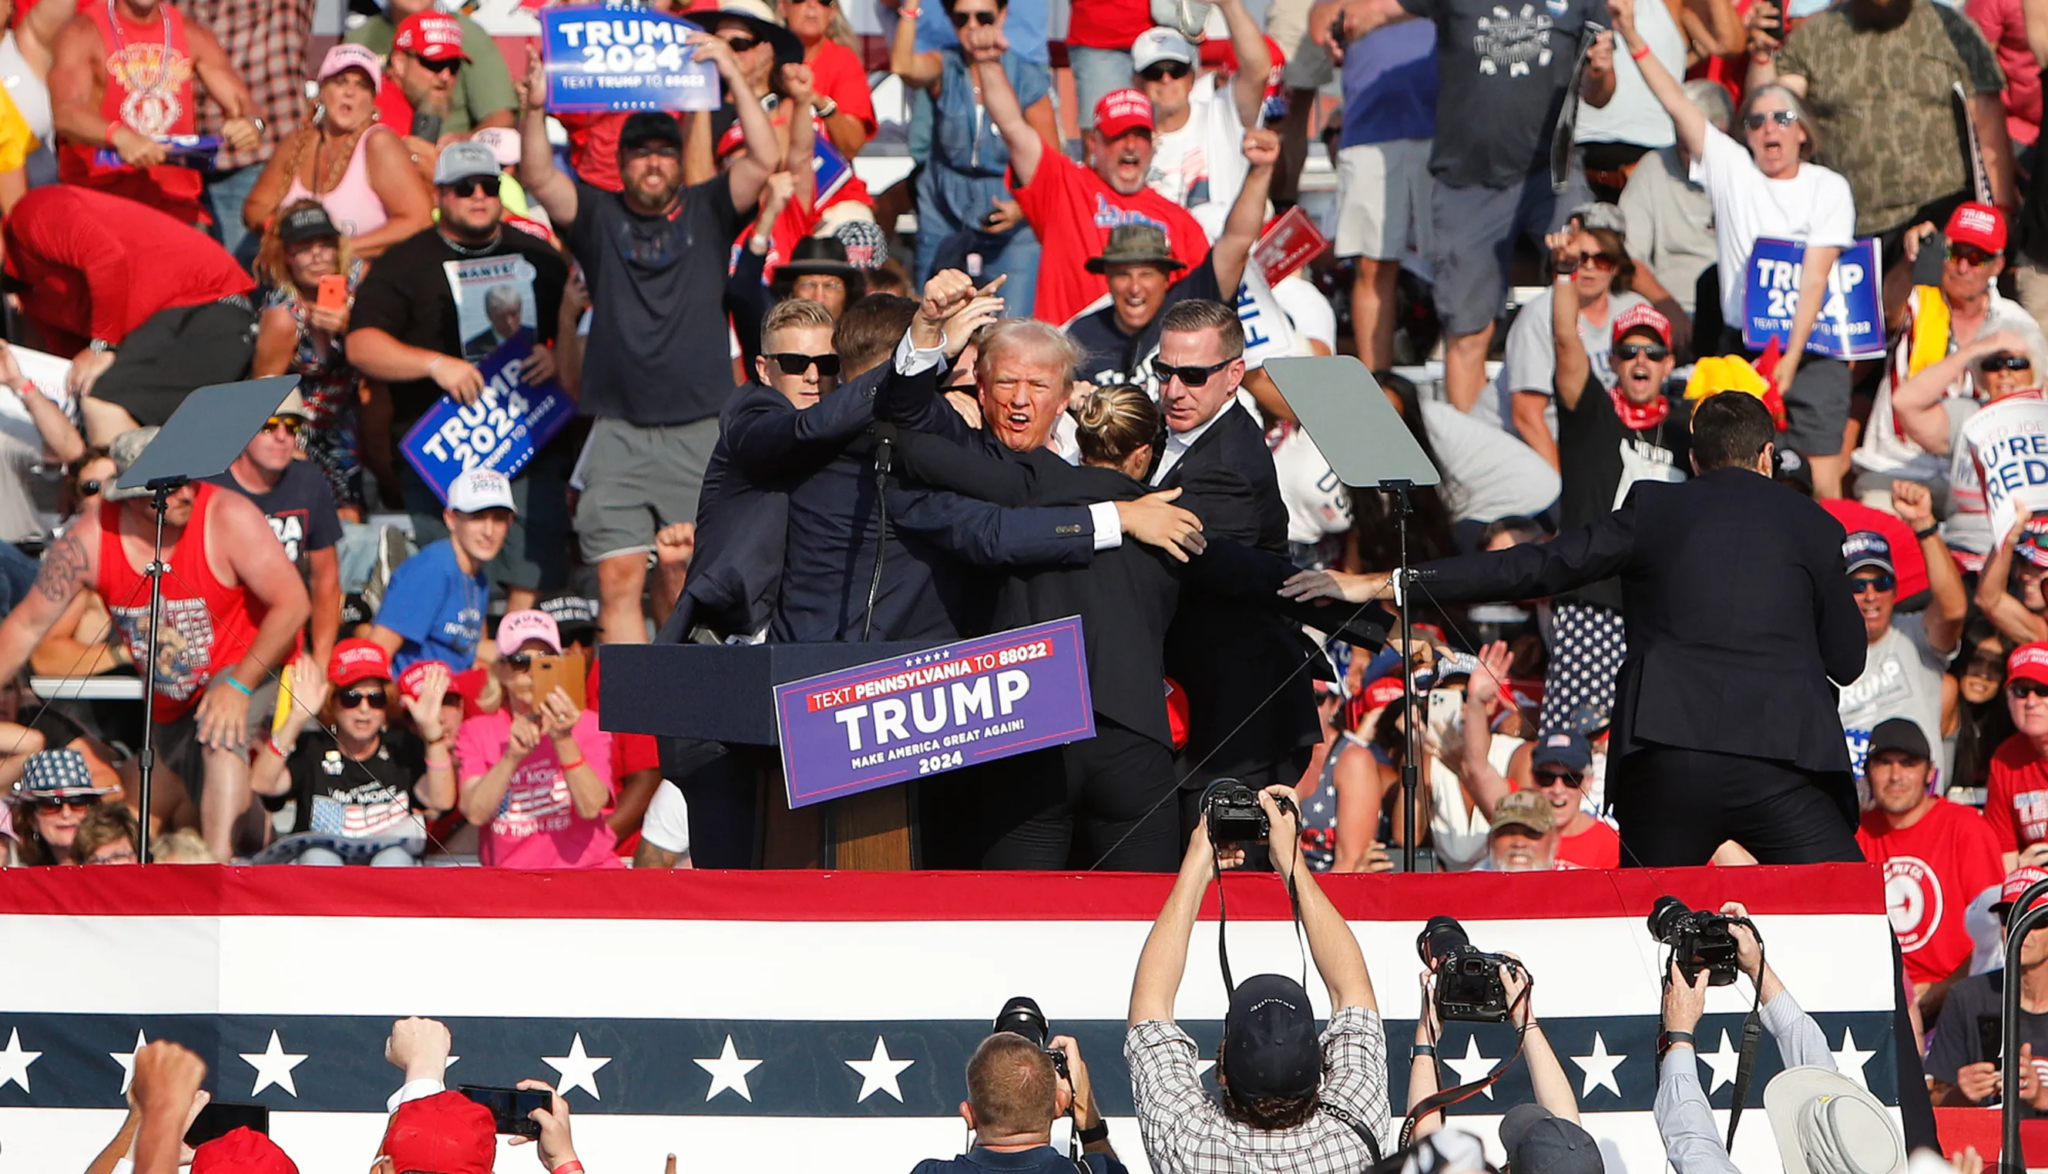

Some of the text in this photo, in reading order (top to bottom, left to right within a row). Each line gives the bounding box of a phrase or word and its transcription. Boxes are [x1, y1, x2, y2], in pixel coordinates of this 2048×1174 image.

[558, 20, 692, 47] TRUMP
[582, 43, 684, 73] 2024
[561, 76, 594, 89] TEXT
[597, 76, 643, 88] TRUMP
[646, 75, 663, 87] TO
[1757, 258, 1864, 294] TRMP
[1767, 289, 1849, 320] 204
[422, 359, 523, 464] TRUMP
[453, 389, 529, 470] 2024
[1984, 435, 2047, 468] U'RE
[1987, 459, 2048, 509] RED
[813, 642, 1047, 709] TEXT PENNSYLVANIA TO 88022
[1840, 660, 1900, 708] RUMP
[835, 669, 1030, 752] TRUMP
[851, 719, 1025, 770] MAKE AMERICA GREAT AGAIN!
[918, 750, 964, 774] 2024
[1322, 1106, 1358, 1127] SONY
[1400, 1116, 1416, 1148] Cano
